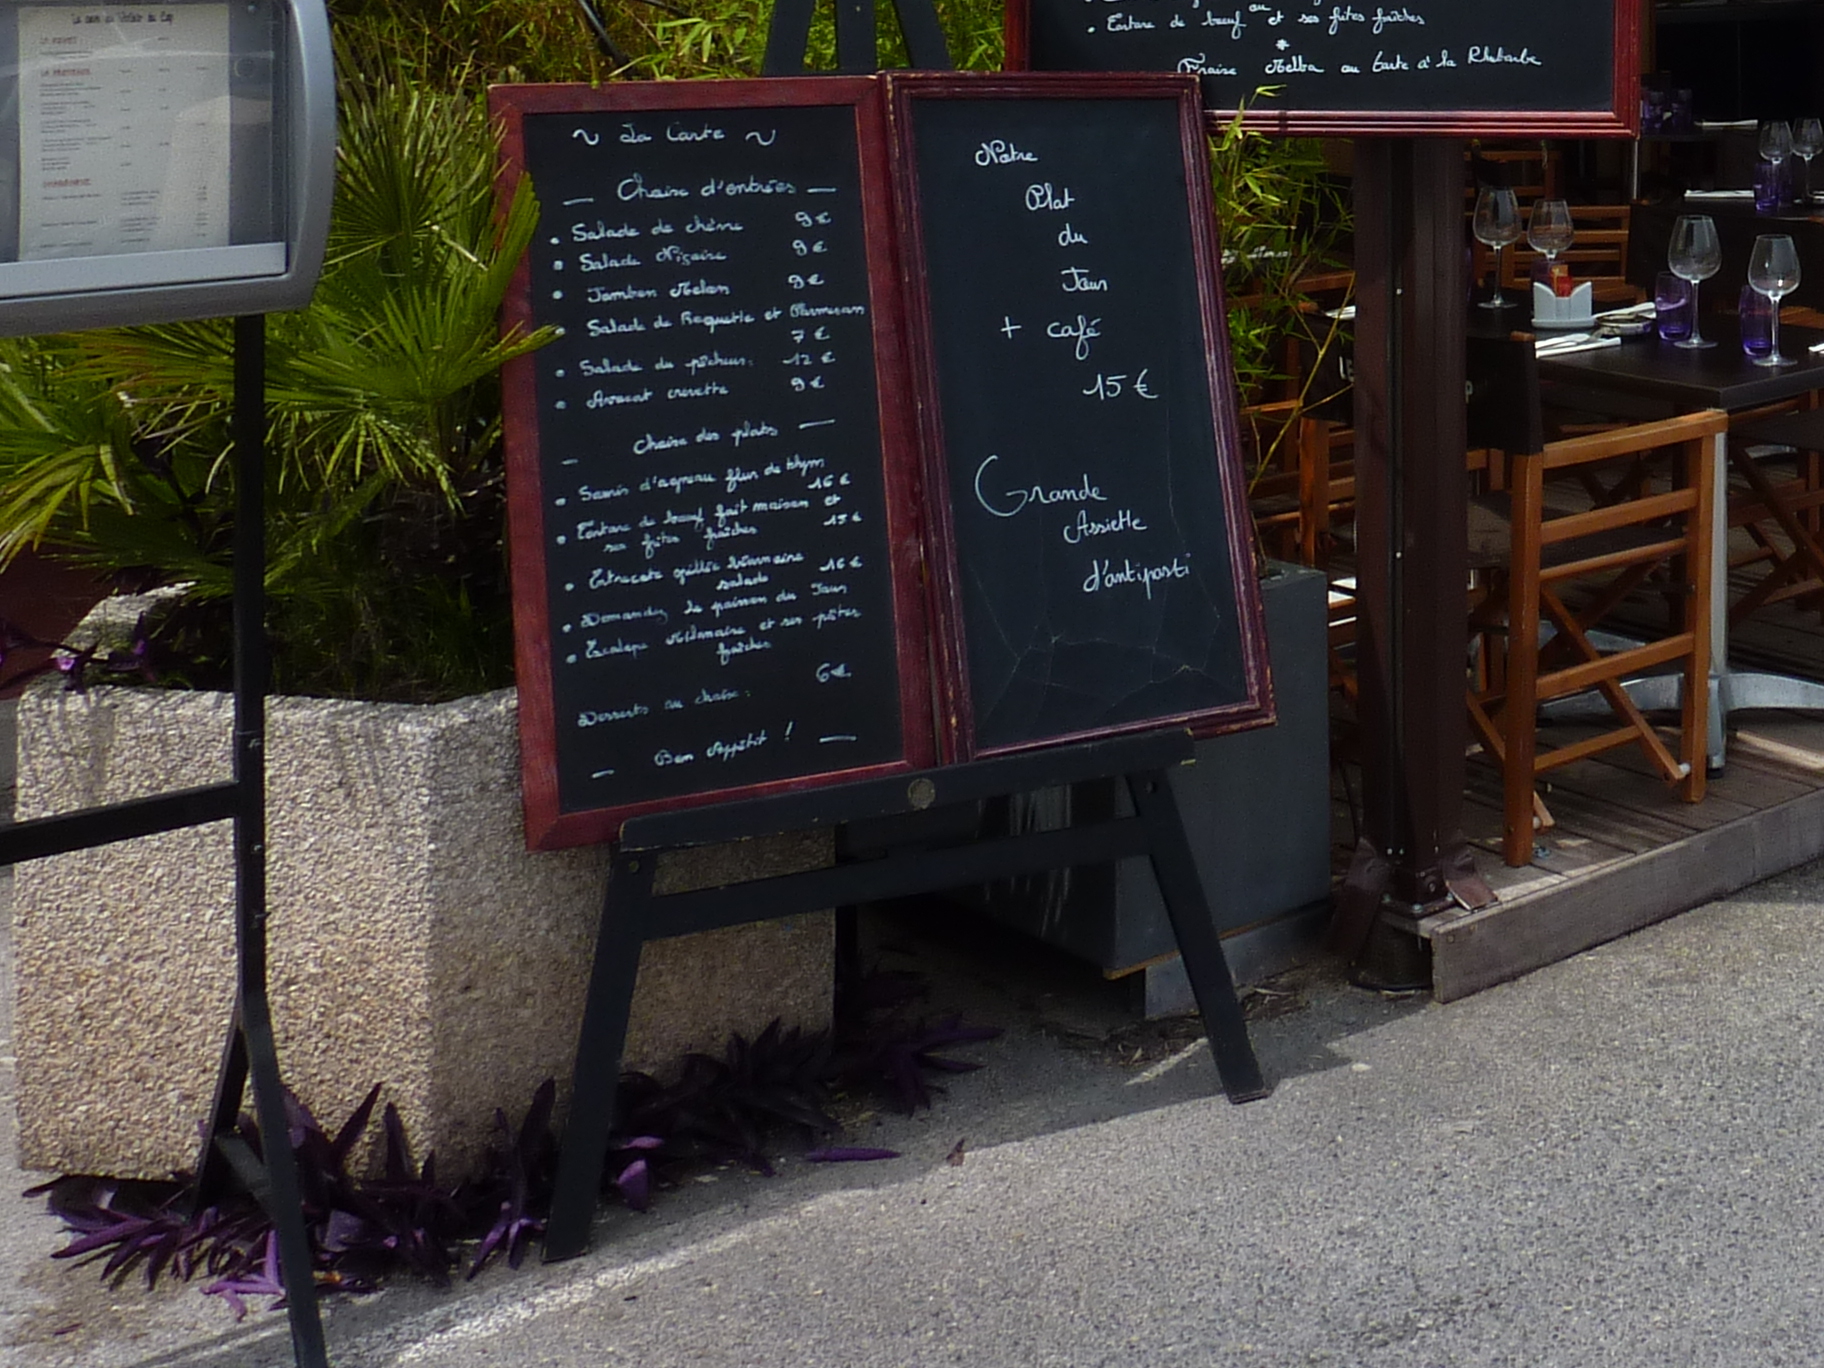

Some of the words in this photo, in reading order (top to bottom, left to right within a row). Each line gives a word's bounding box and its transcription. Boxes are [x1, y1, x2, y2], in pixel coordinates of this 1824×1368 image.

[1249, 2, 1271, 12] ou
[1107, 13, 1155, 32] Tartare
[1170, 14, 1186, 28] de
[1267, 13, 1284, 26] et
[1298, 14, 1320, 24] ses
[1177, 52, 1237, 75] Fraise
[1265, 55, 1325, 74] Melba
[1341, 63, 1360, 74] ou
[1436, 49, 1456, 68] la
[620, 123, 652, 142] La
[667, 122, 725, 141] Carte
[975, 139, 1038, 166] Notre
[1025, 182, 1075, 211] Plat
[572, 220, 640, 242] Salade
[651, 218, 673, 234] de
[1058, 222, 1088, 246] du
[578, 252, 641, 272] Salade
[1061, 266, 1108, 292] Jour
[587, 286, 657, 303] Jambon
[669, 281, 731, 298] Melon
[586, 318, 646, 337] Salade
[653, 315, 672, 329] de
[764, 306, 783, 320] et
[790, 302, 865, 319] Parmesan
[1047, 315, 1102, 361] café
[579, 358, 643, 377] Salade
[655, 356, 674, 370] du
[586, 389, 653, 410] Avocat
[696, 428, 719, 444] des
[731, 421, 779, 446] plats
[763, 462, 782, 476] de
[785, 454, 825, 478] thym
[975, 454, 1108, 517] Grande
[577, 519, 631, 540] Tartare
[638, 513, 656, 528] de
[714, 502, 748, 528] fait
[752, 497, 809, 514] maison
[824, 493, 842, 507] et
[1063, 509, 1148, 544] Assiette
[603, 540, 627, 553] ses
[715, 572, 770, 591] salade
[1082, 552, 1190, 600] d'antipasti
[580, 607, 668, 629] Demandez
[710, 593, 768, 619] poisson
[775, 589, 797, 603] du
[810, 581, 847, 597] Jour
[585, 639, 649, 661] Escalope
[759, 616, 774, 631] et
[780, 615, 803, 627] ses
[577, 702, 649, 728] Desserts
[663, 698, 684, 711] au
[654, 749, 694, 767] Bon
